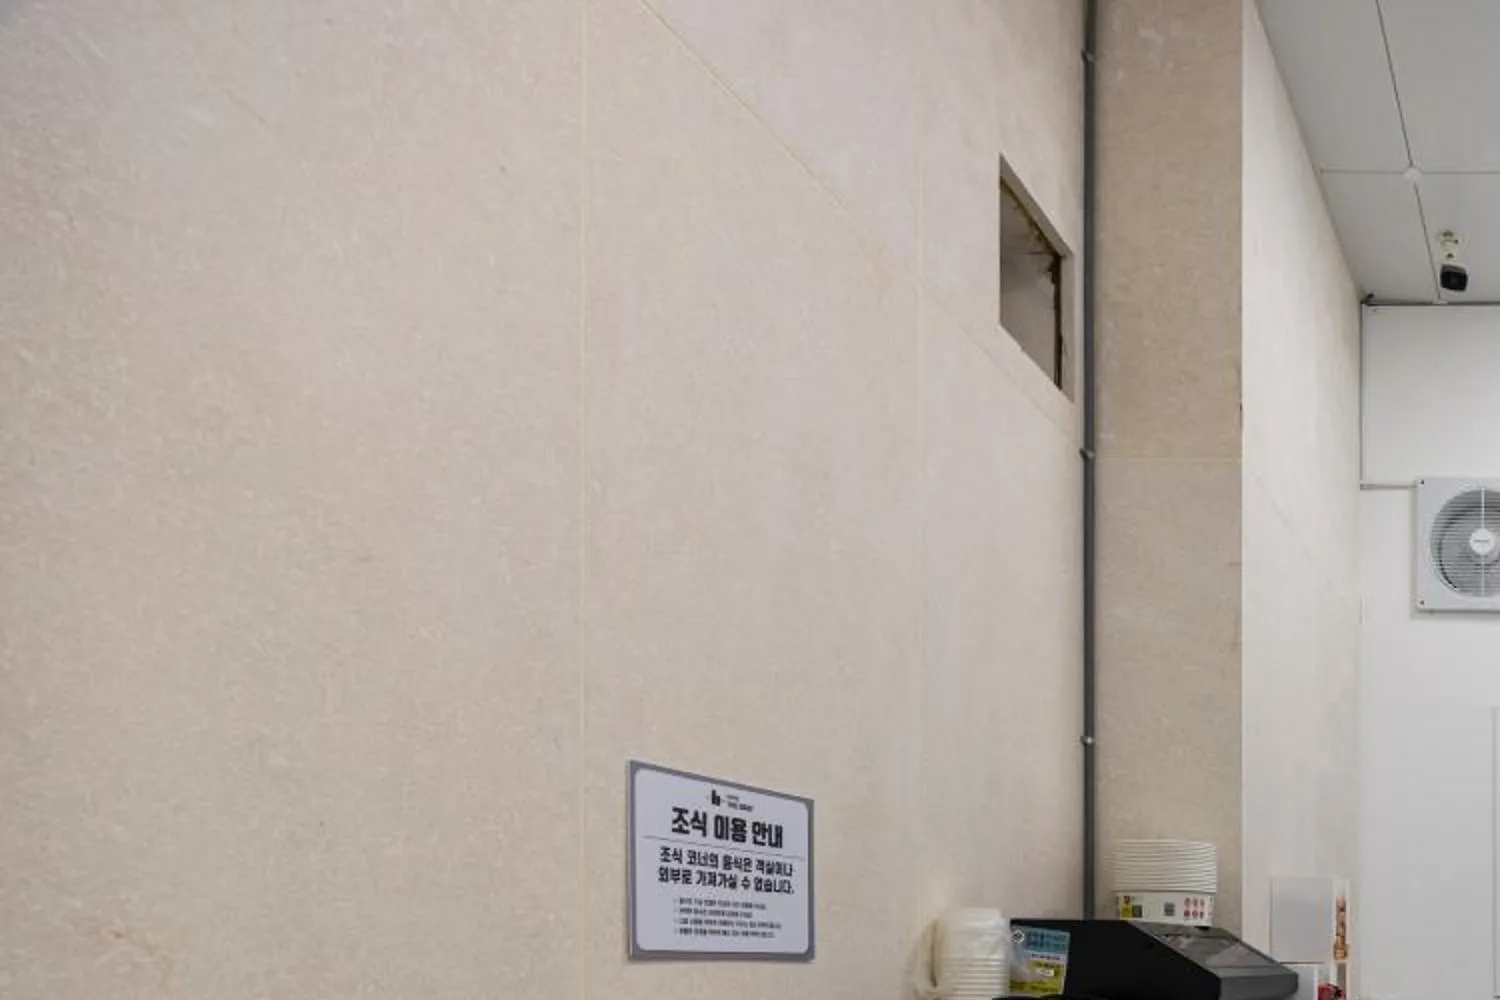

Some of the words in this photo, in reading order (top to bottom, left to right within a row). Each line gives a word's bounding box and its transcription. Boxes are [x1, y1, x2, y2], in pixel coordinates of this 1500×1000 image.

[671, 806, 707, 838] 조식
[714, 814, 747, 843] 이용
[751, 821, 783, 849] 안내
[660, 846, 683, 865] 조식
[686, 849, 719, 869] 코너의
[722, 854, 753, 873] 음식은
[658, 866, 692, 885] 외부로
[695, 869, 737, 889] 가져가실
[741, 875, 751, 890] 수
[753, 876, 795, 894] 없습니다.
